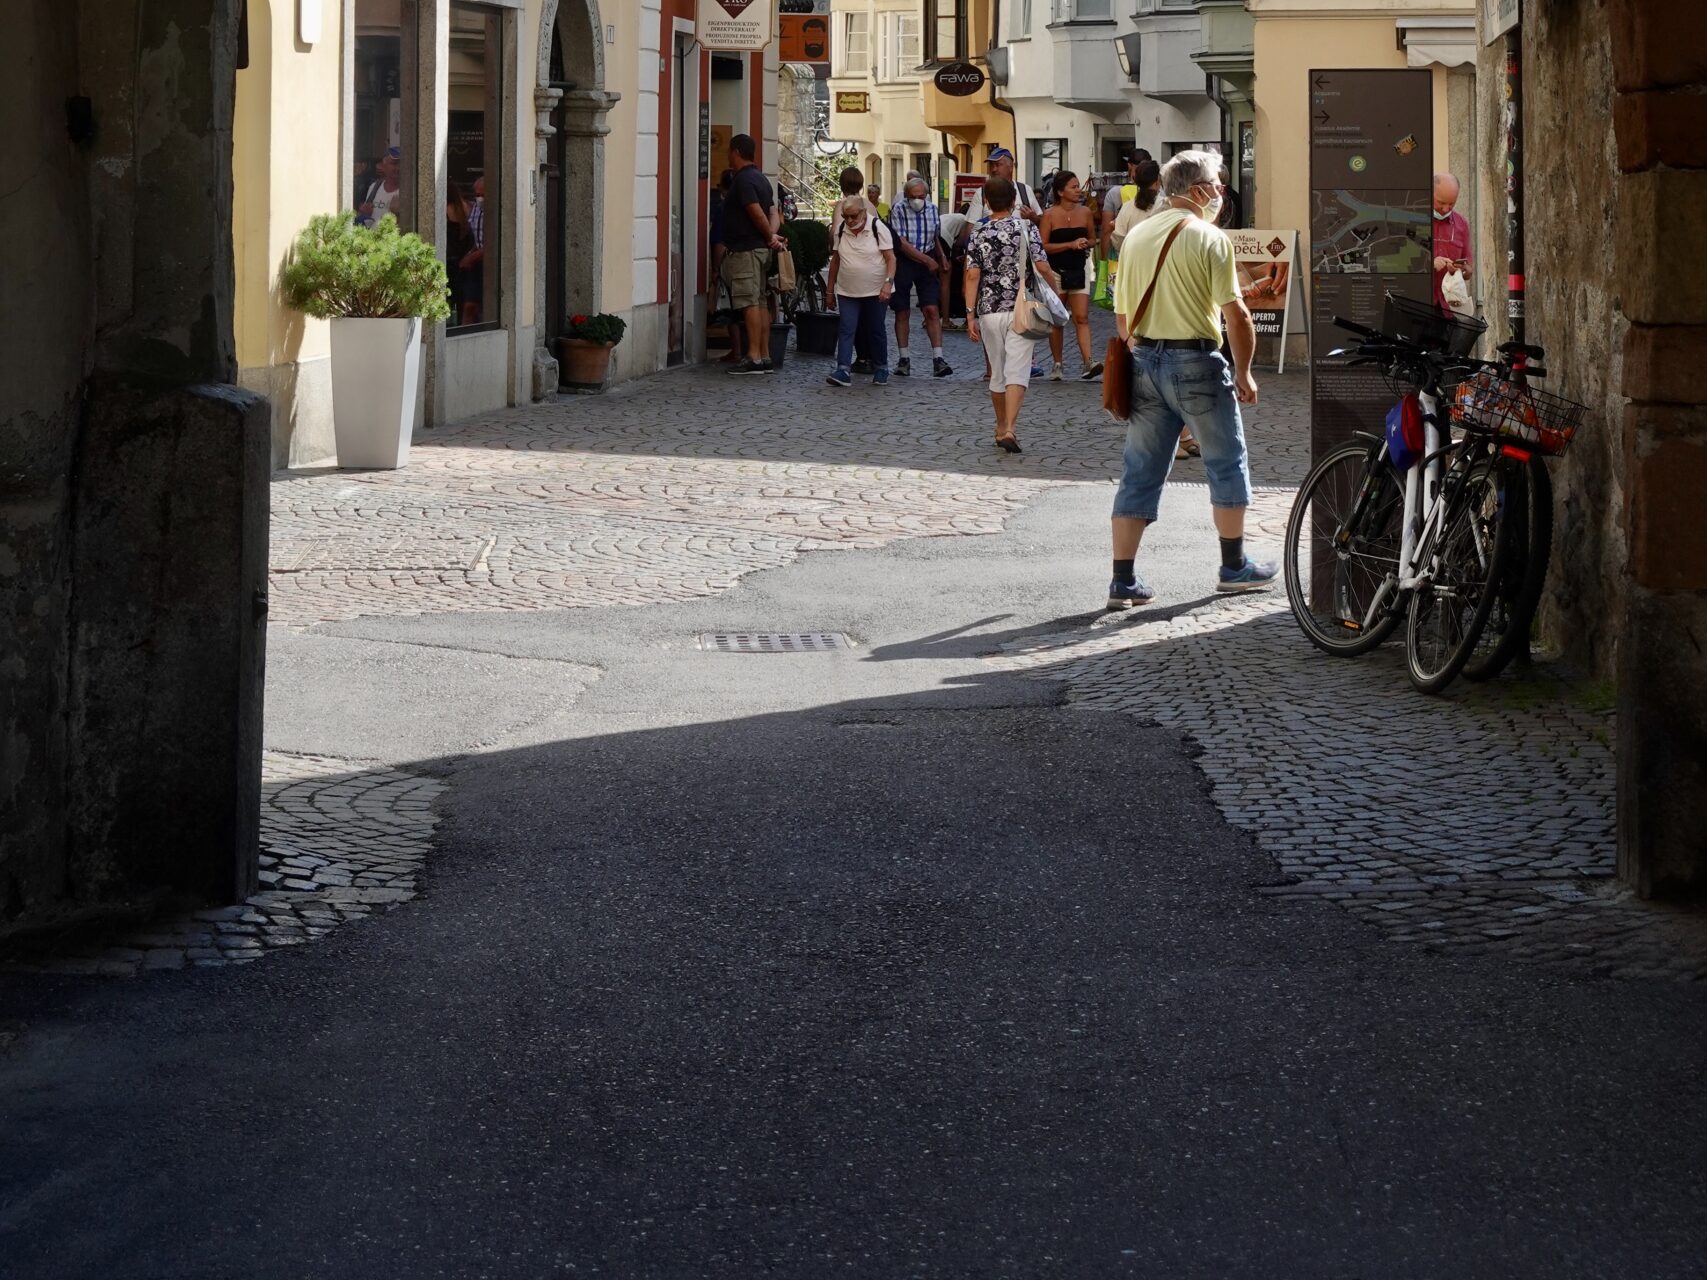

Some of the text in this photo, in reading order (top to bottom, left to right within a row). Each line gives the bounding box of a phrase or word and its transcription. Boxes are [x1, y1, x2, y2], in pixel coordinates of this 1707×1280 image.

[1234, 241, 1264, 257] peck
[1251, 313, 1276, 321] APERTO
[1253, 323, 1280, 333] EÖFFNET
